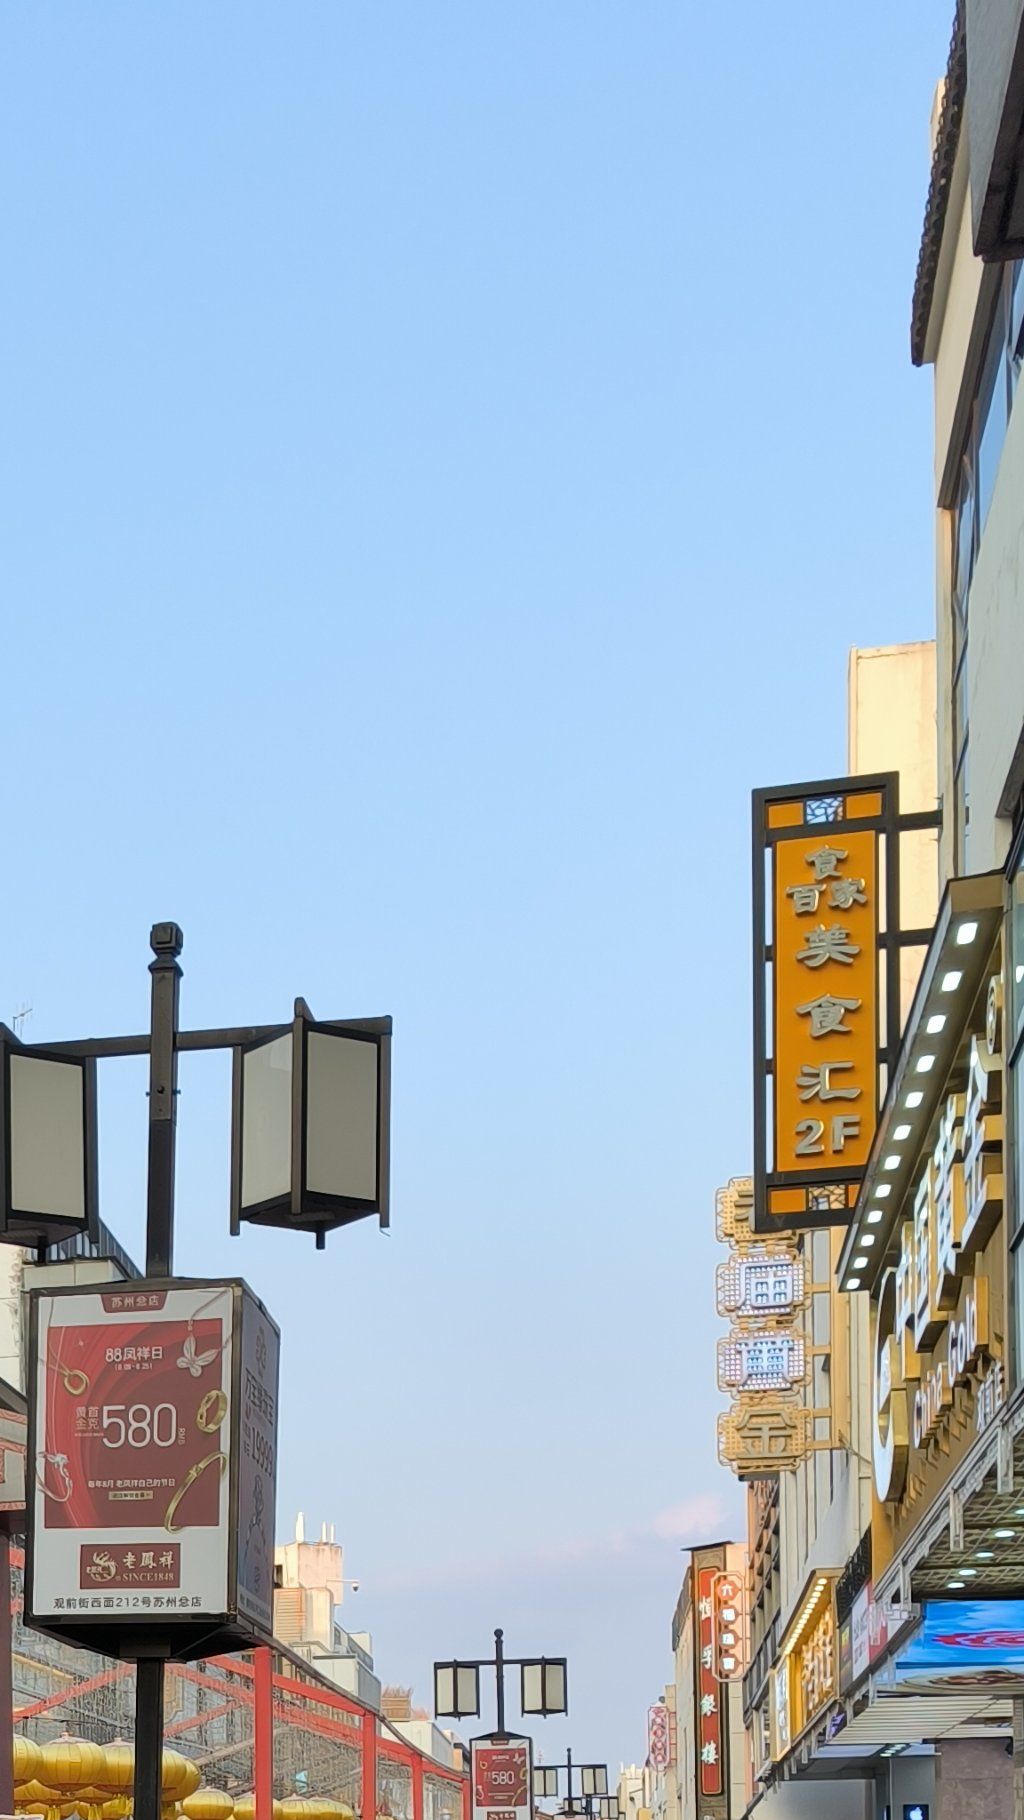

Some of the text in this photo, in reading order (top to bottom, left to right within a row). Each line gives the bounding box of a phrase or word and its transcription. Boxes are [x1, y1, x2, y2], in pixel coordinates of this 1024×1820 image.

[795, 1114, 861, 1157] 2F
[111, 1295, 160, 1308] 苏州总店
[105, 1346, 163, 1362] 88凤祥日
[913, 1278, 979, 1449] China Gold
[102, 1403, 177, 1448] 580
[491, 1770, 515, 1786] 580
